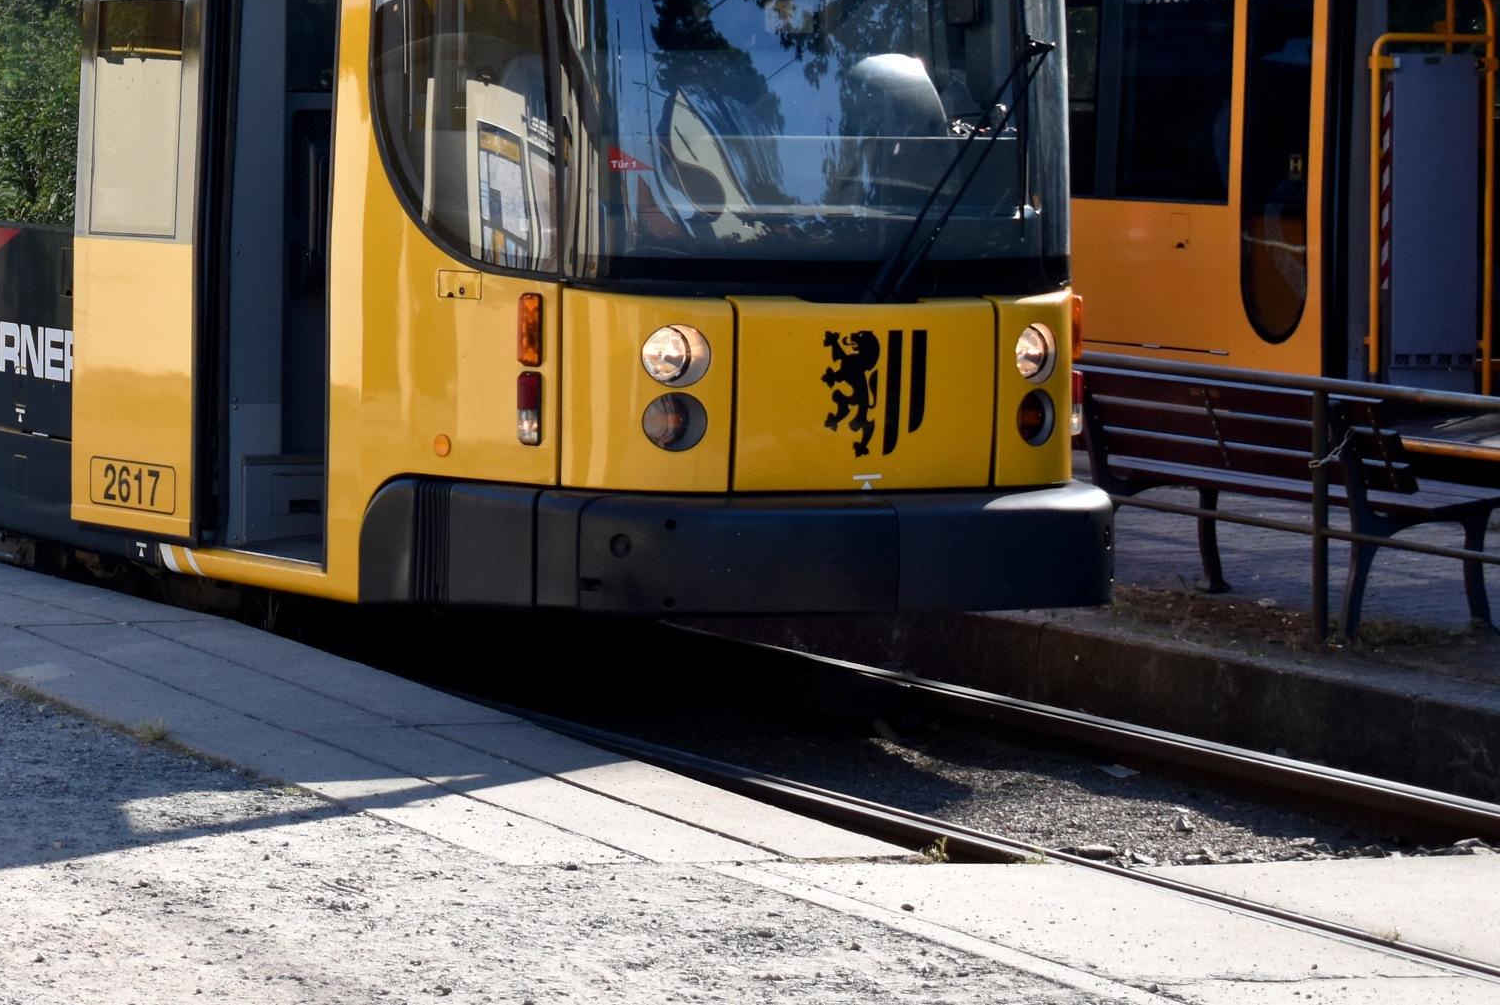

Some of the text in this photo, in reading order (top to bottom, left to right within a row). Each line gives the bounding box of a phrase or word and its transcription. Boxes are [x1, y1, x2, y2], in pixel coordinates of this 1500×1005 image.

[610, 159, 637, 169] Tür 1
[103, 463, 161, 507] 2617
